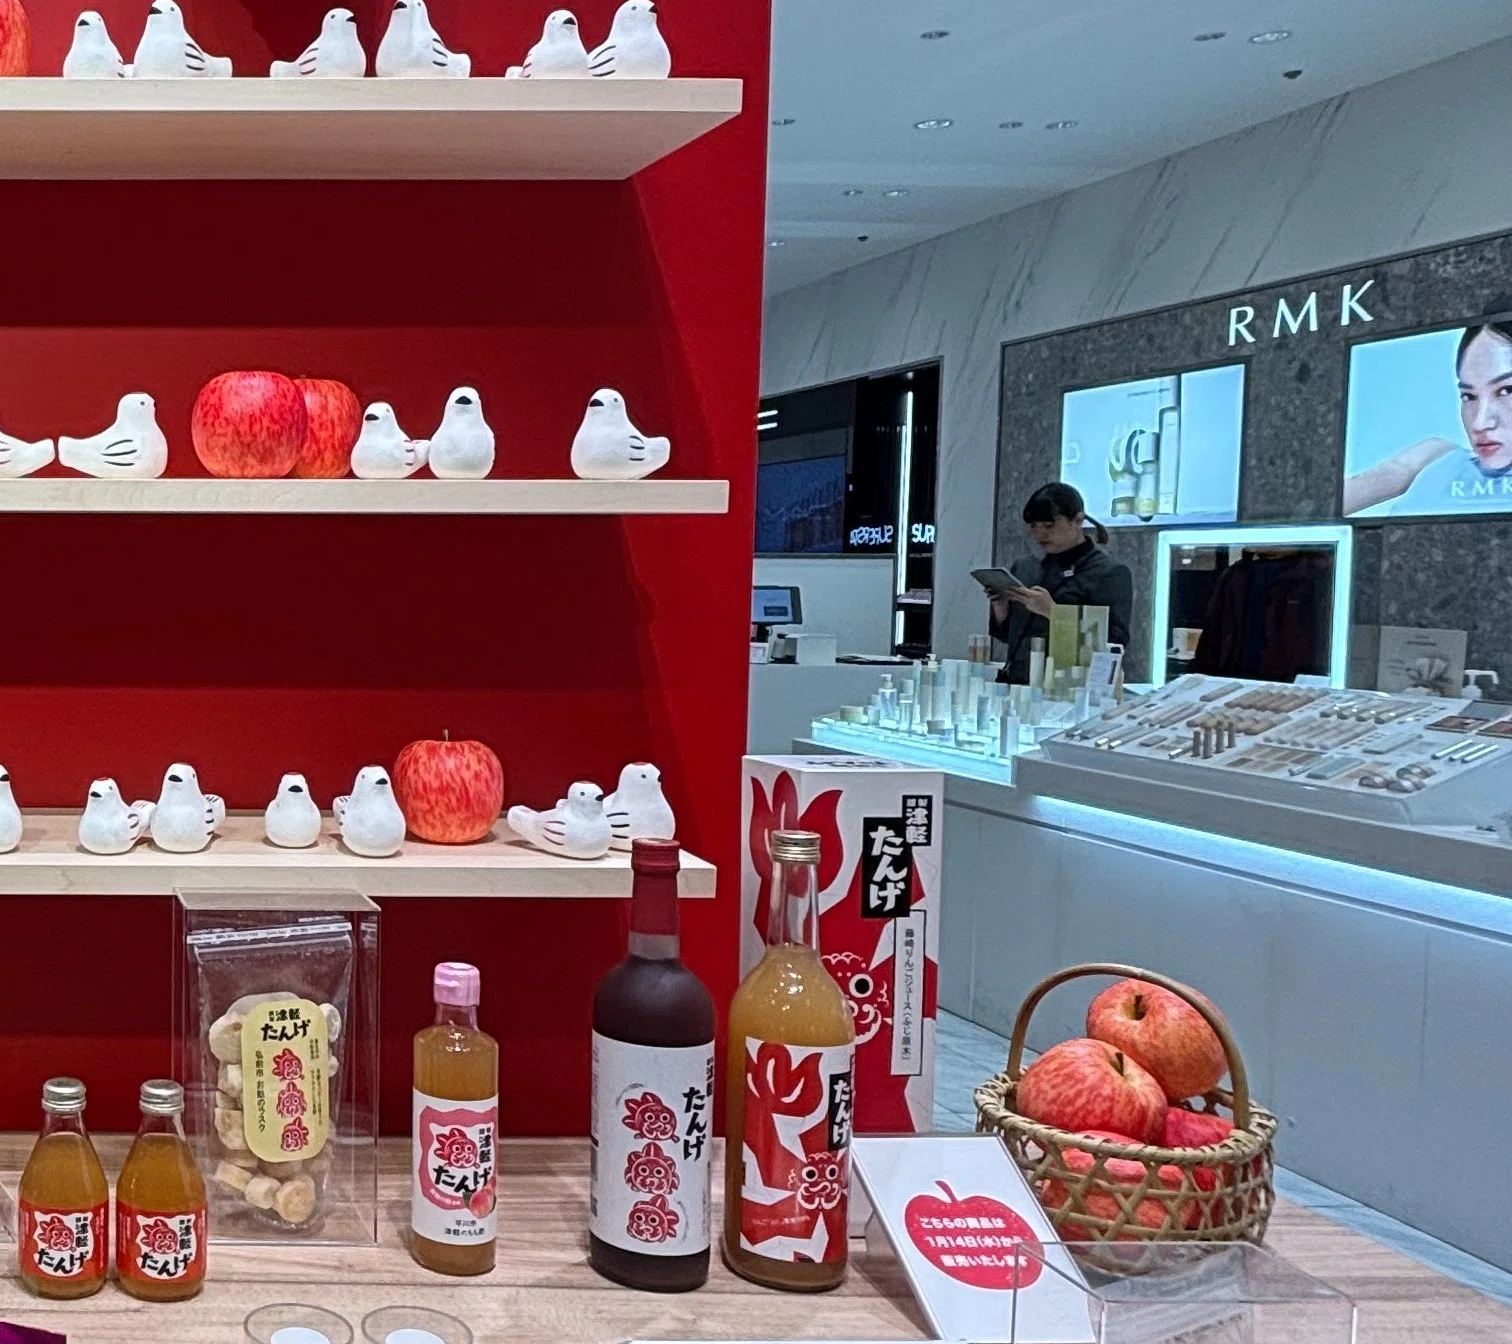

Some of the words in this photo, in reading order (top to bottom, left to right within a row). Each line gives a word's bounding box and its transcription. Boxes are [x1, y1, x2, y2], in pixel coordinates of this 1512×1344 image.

[1227, 279, 1376, 347] RMK
[1451, 476, 1512, 500] RMK
[868, 825, 908, 912] たんげ
[260, 1019, 311, 1042] たんげ
[682, 1086, 707, 1162] たんげ
[432, 1165, 492, 1194] たんげ
[37, 1248, 90, 1274] たんげ
[140, 1251, 193, 1278] たんげ
